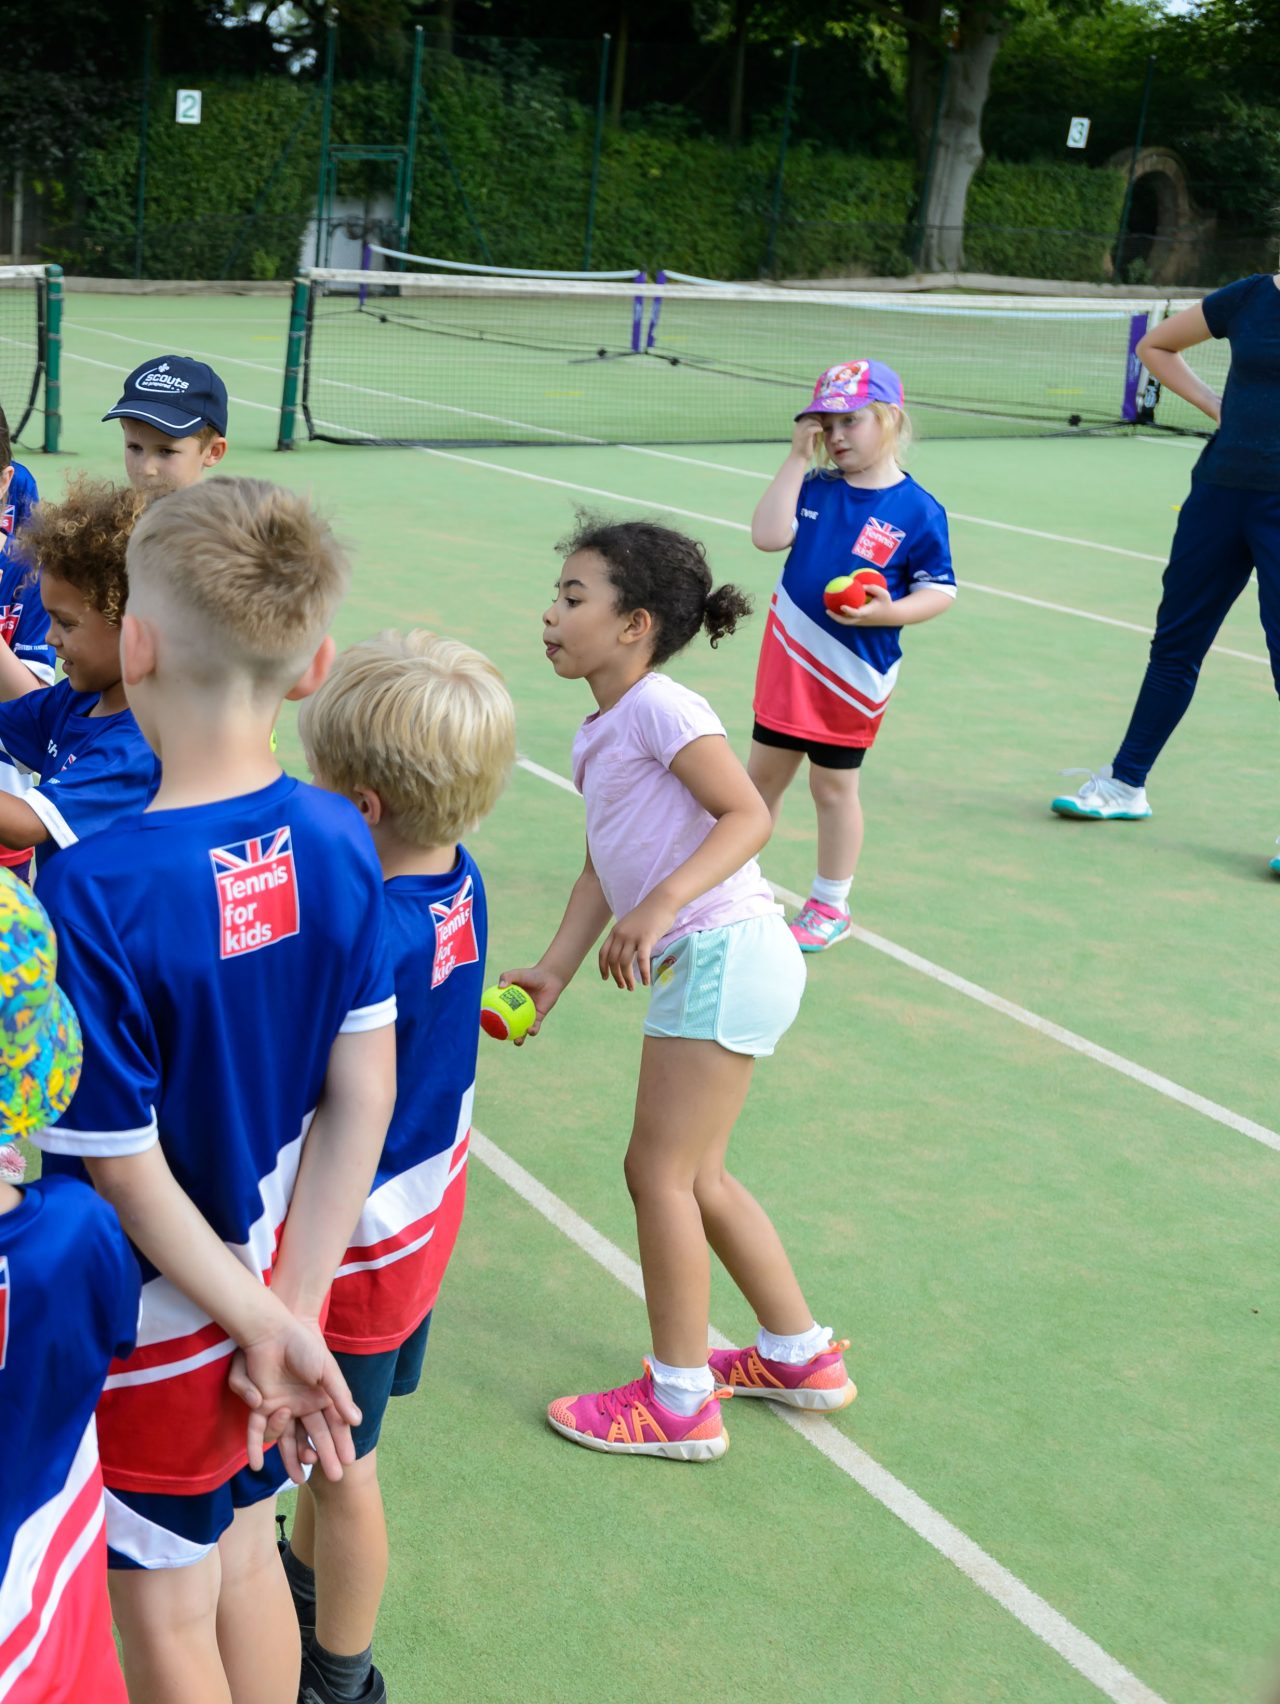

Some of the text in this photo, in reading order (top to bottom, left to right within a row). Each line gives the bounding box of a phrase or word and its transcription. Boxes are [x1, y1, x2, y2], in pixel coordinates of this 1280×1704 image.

[181, 94, 197, 119] 2
[1071, 121, 1085, 144] 3
[145, 373, 190, 389] scouts
[864, 526, 895, 549] Tennis
[220, 863, 289, 902] Tennis
[224, 902, 258, 928] for
[438, 907, 470, 945] Tennis
[225, 920, 272, 953] kids
[437, 941, 454, 964] for
